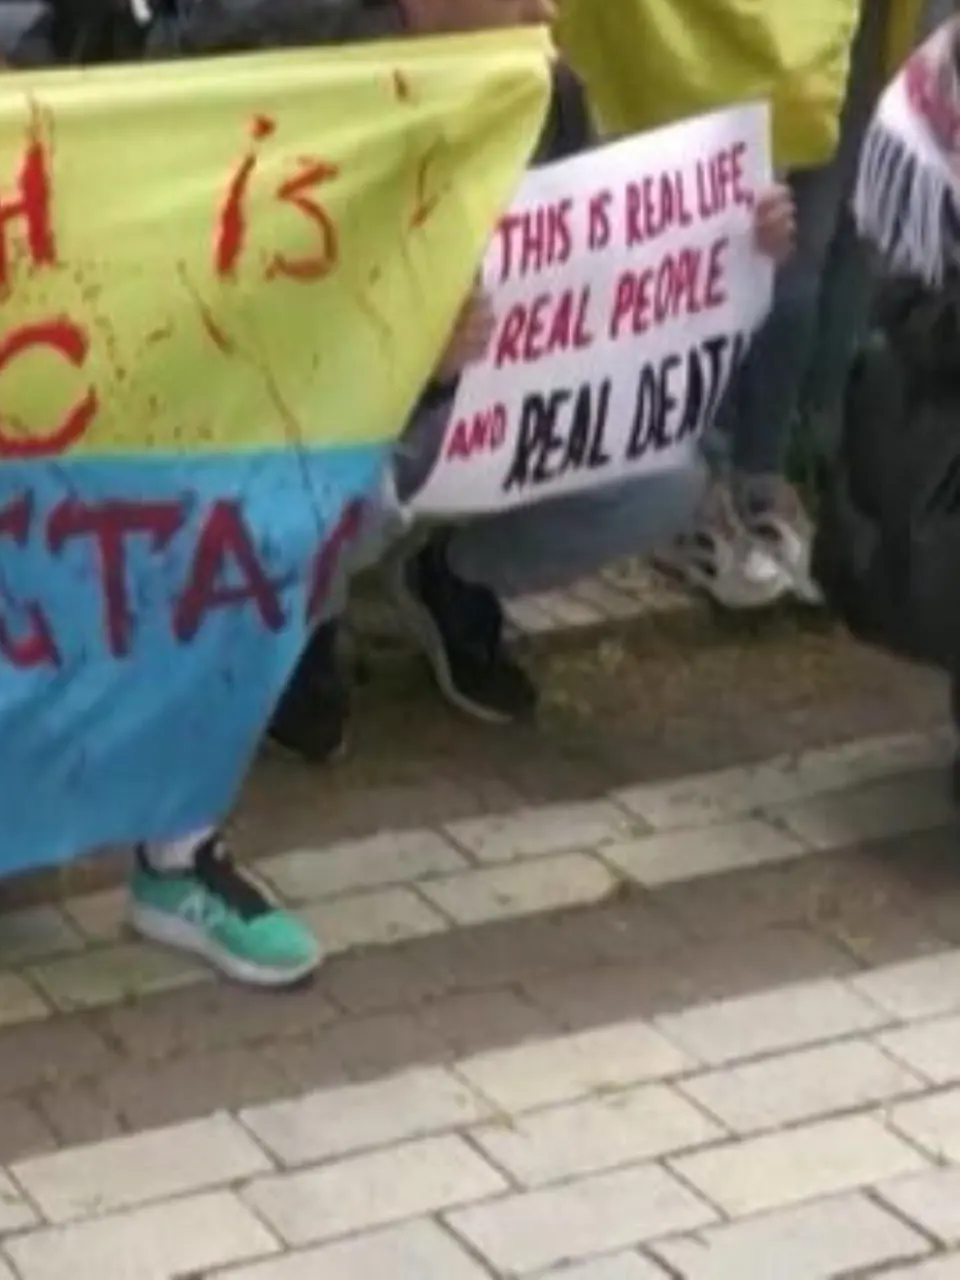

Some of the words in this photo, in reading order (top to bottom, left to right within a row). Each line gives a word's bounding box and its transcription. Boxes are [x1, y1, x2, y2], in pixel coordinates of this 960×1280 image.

[496, 197, 573, 283] THIS
[587, 188, 613, 249] IS
[625, 170, 690, 248] REAL
[494, 282, 594, 369] REAL
[608, 237, 730, 341] PEOPLE
[445, 401, 507, 462] AND
[502, 378, 611, 493] REAL
